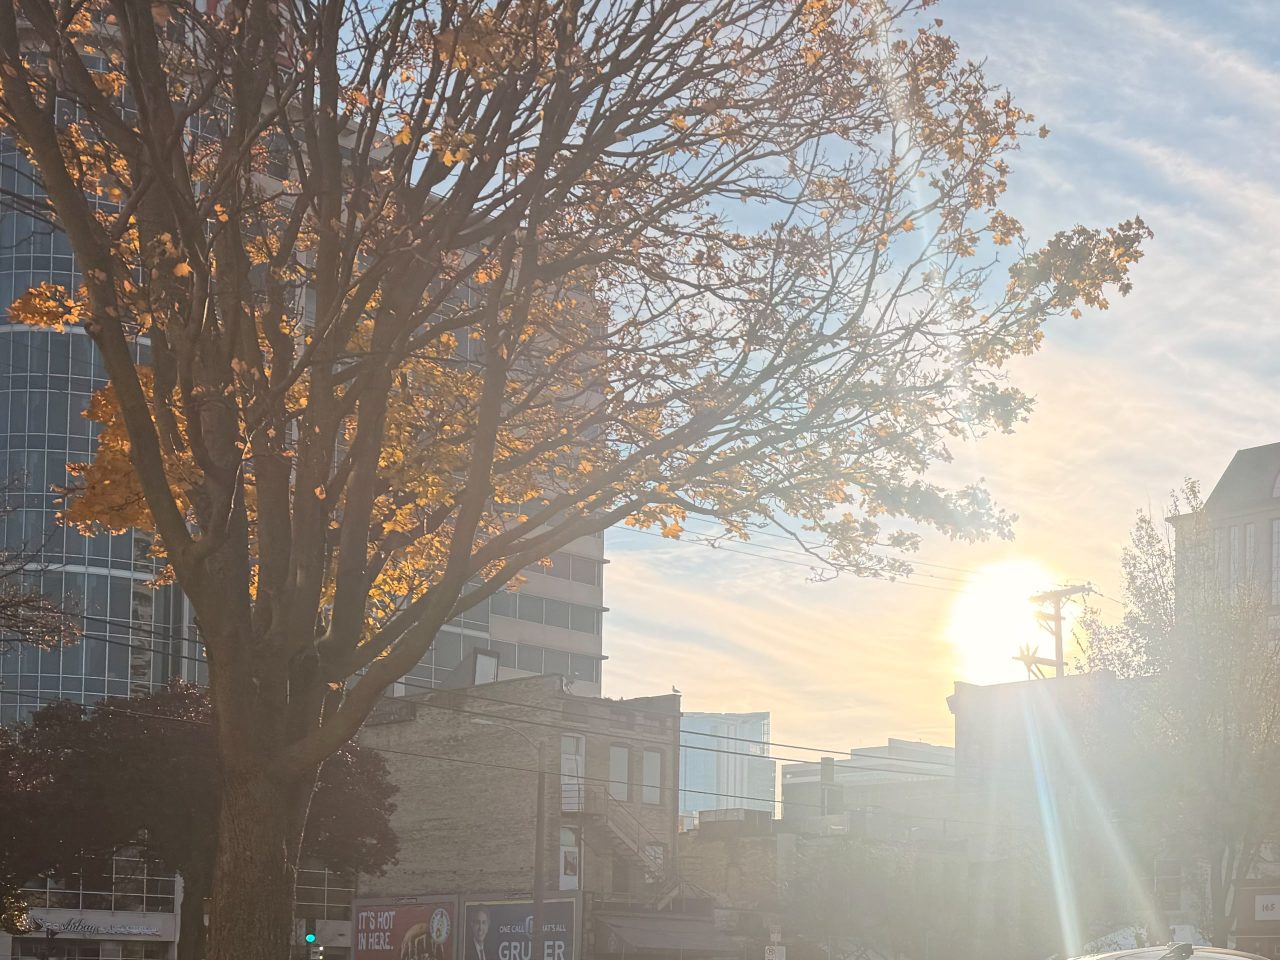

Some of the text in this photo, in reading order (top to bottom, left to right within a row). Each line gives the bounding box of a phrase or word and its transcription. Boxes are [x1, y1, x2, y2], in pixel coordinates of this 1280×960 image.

[1262, 903, 1276, 912] 165
[358, 911, 395, 930] IT'S HOT
[499, 924, 510, 932] ONE
[512, 924, 525, 932] CALL
[556, 924, 566, 932] ALL
[358, 932, 394, 950] IN HERE.
